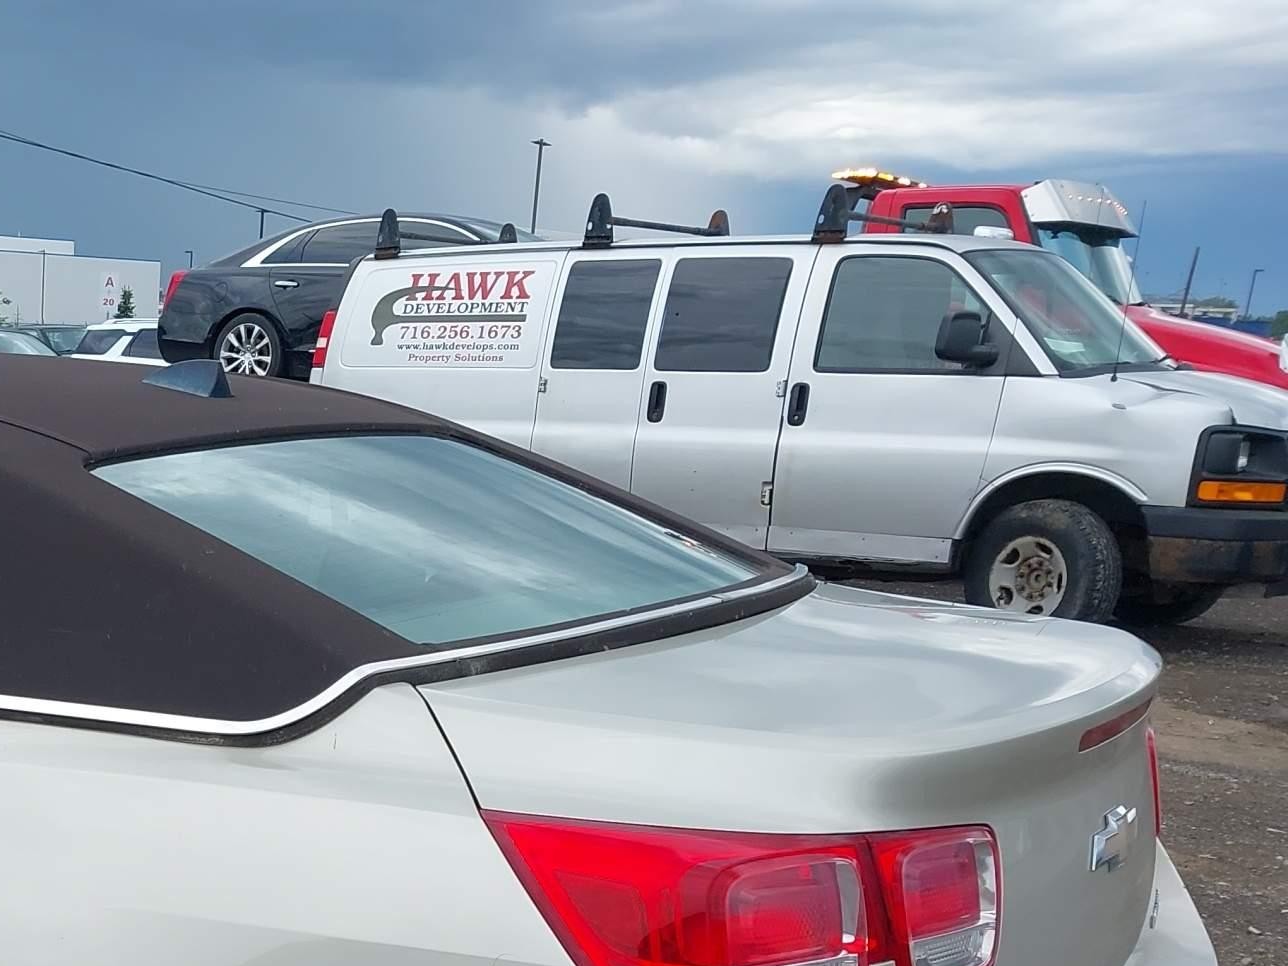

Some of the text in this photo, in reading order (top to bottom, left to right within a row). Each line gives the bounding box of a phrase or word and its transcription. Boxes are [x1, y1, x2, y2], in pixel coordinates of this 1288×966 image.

[105, 276, 114, 287] A
[406, 270, 536, 301] HAWK
[103, 298, 115, 306] 20
[402, 302, 528, 315] DEVELOPMENT
[400, 325, 522, 340] 716.256.1673
[397, 342, 519, 353] www.hawkdevelops.com
[408, 353, 504, 363] Property Solutions
